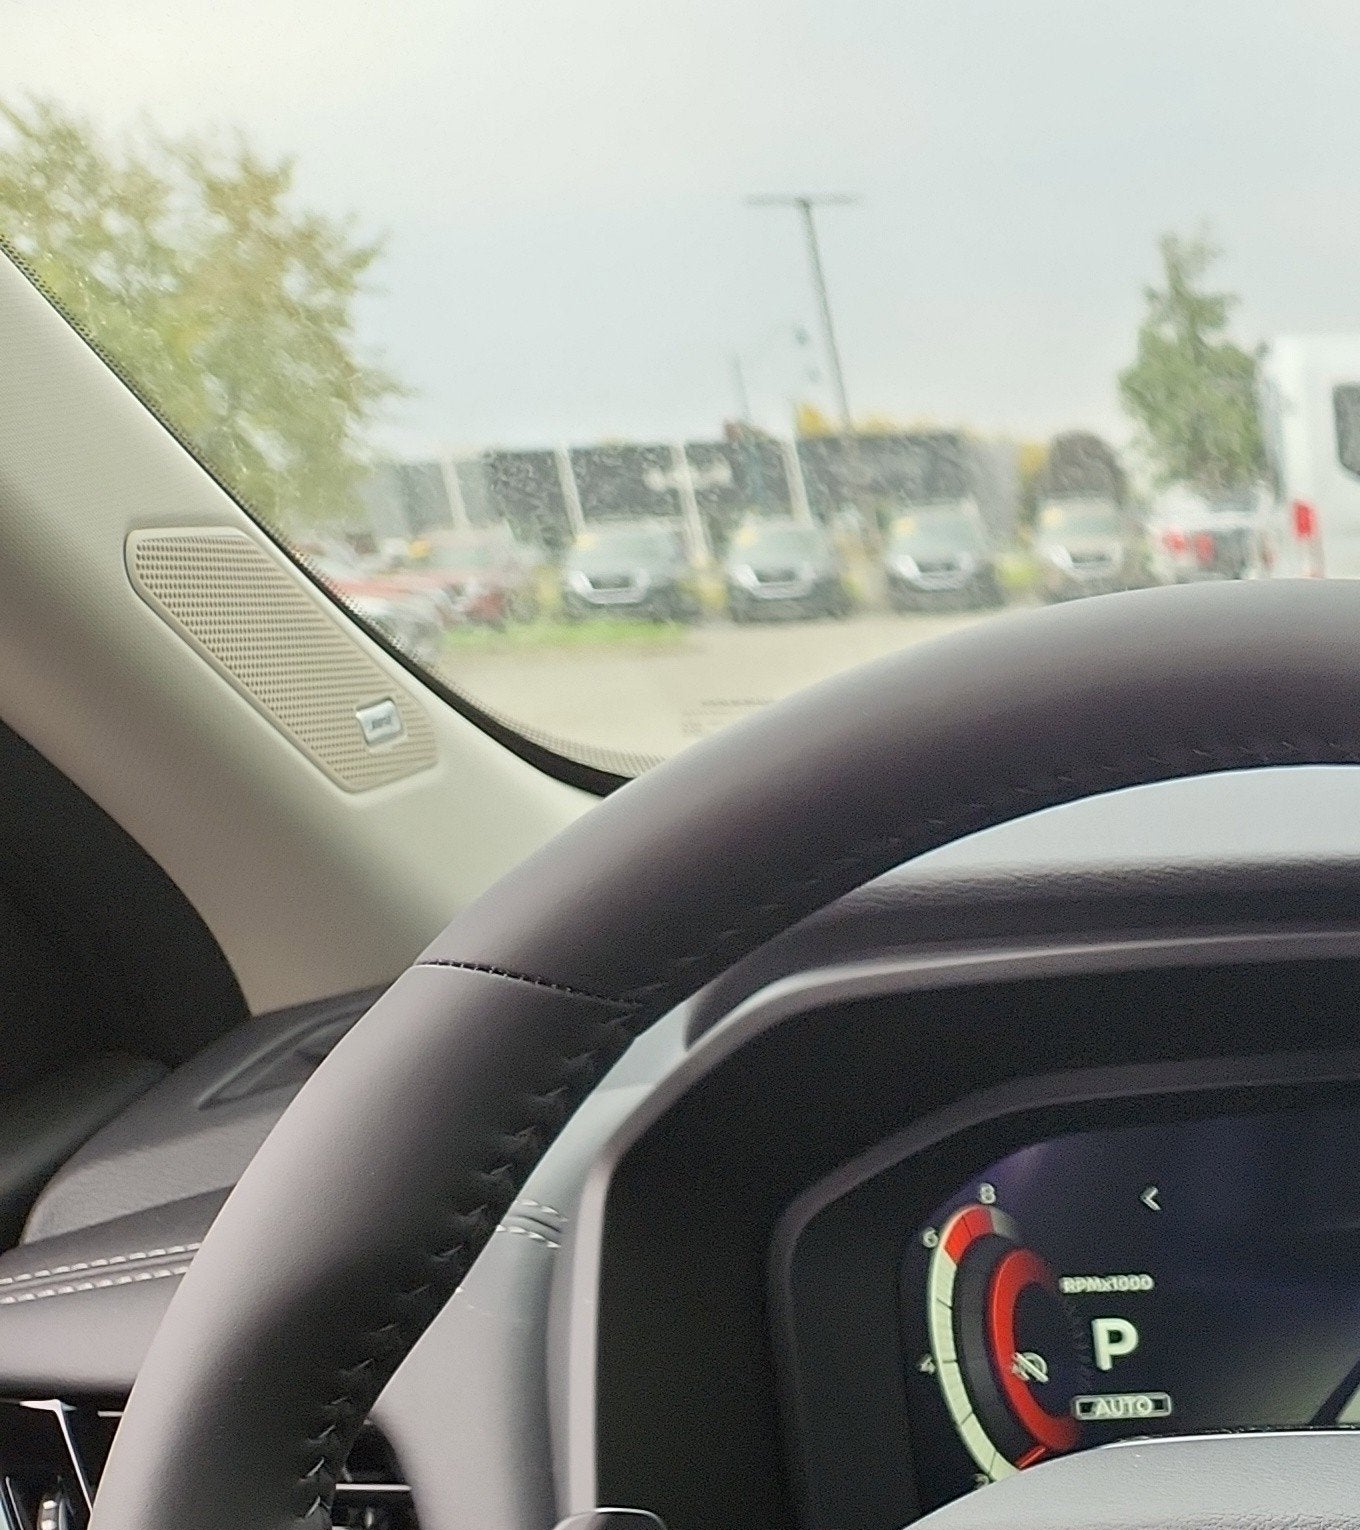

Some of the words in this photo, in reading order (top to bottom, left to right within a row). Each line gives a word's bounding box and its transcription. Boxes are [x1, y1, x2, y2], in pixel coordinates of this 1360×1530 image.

[979, 1183, 997, 1205] 8
[1091, 1318, 1139, 1371] P
[1093, 1396, 1154, 1416] AUTO
